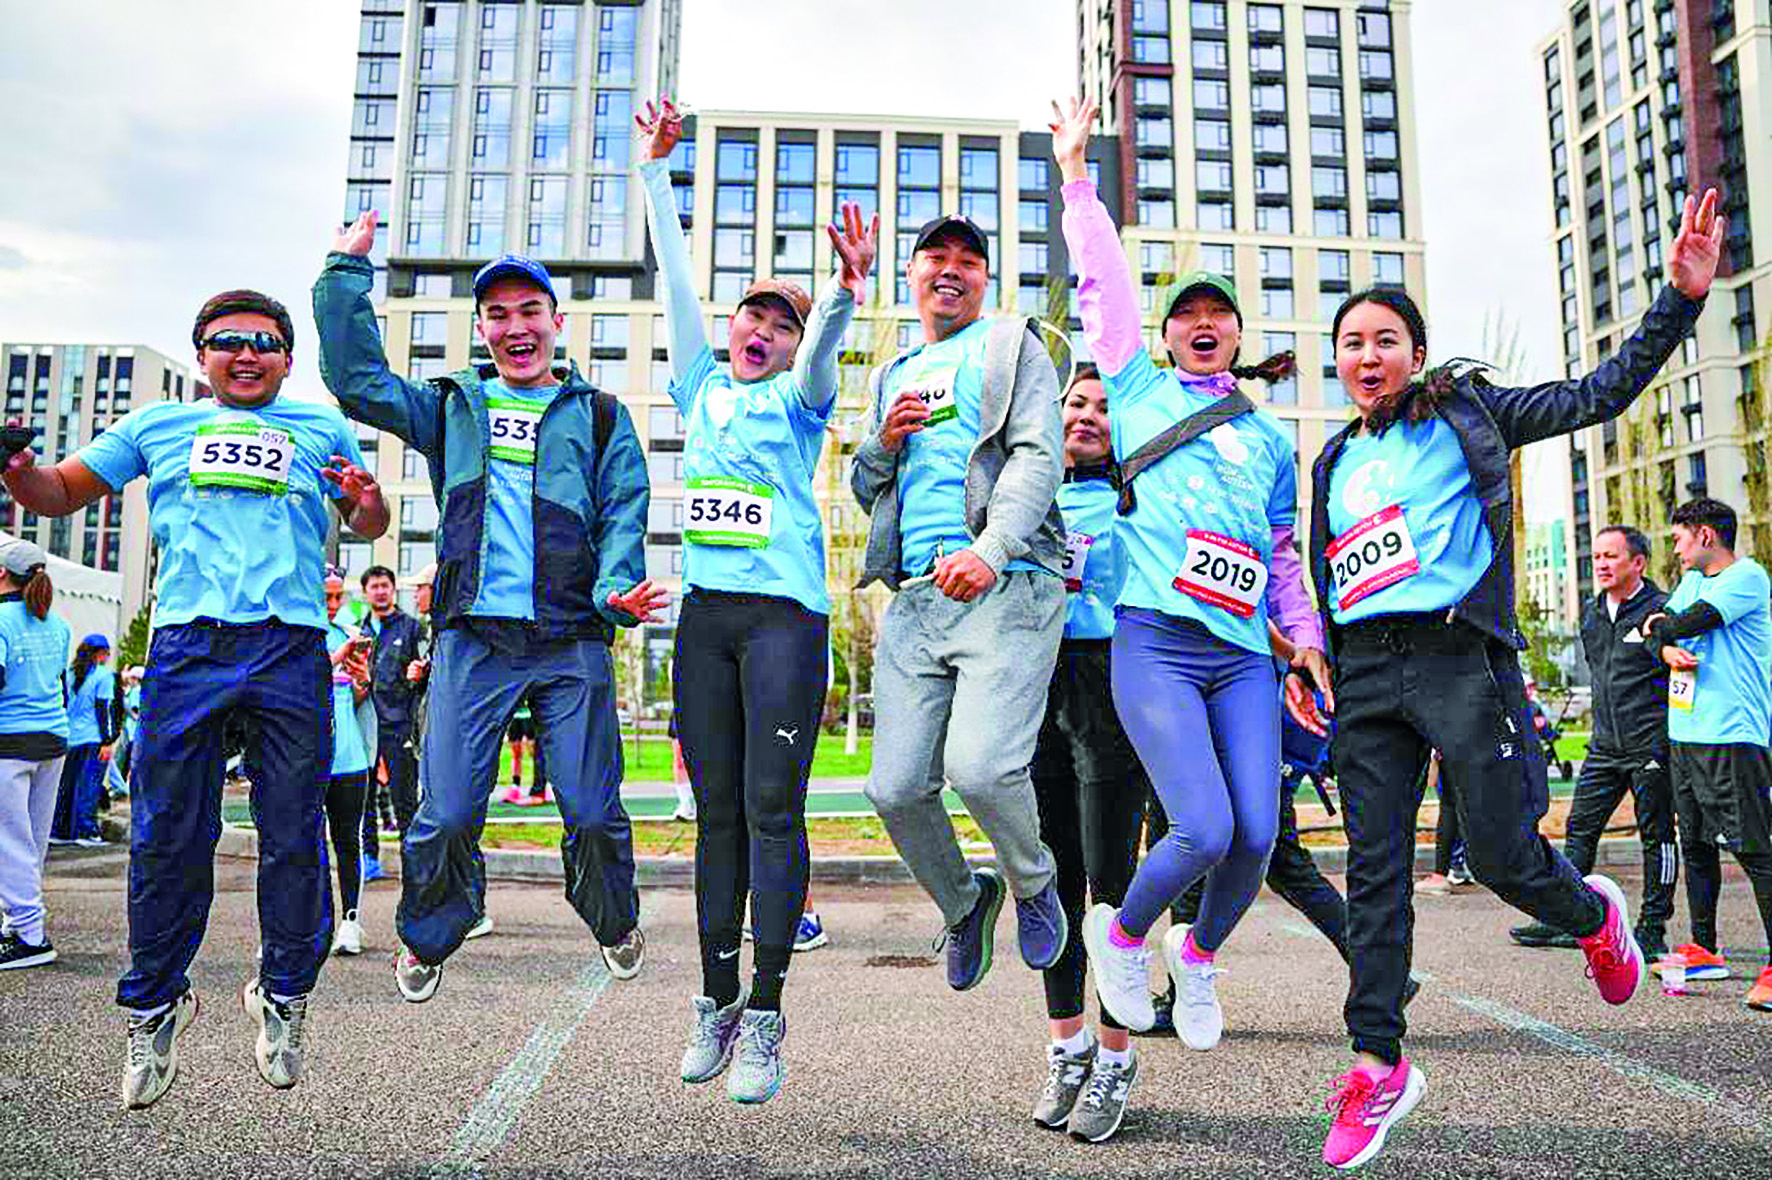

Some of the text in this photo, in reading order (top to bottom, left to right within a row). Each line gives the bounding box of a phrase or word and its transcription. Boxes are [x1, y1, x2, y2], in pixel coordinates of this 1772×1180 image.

[202, 442, 283, 472] 5352
[690, 498, 762, 525] 5346
[1191, 550, 1257, 592] 2019
[1336, 531, 1402, 588] 2009
